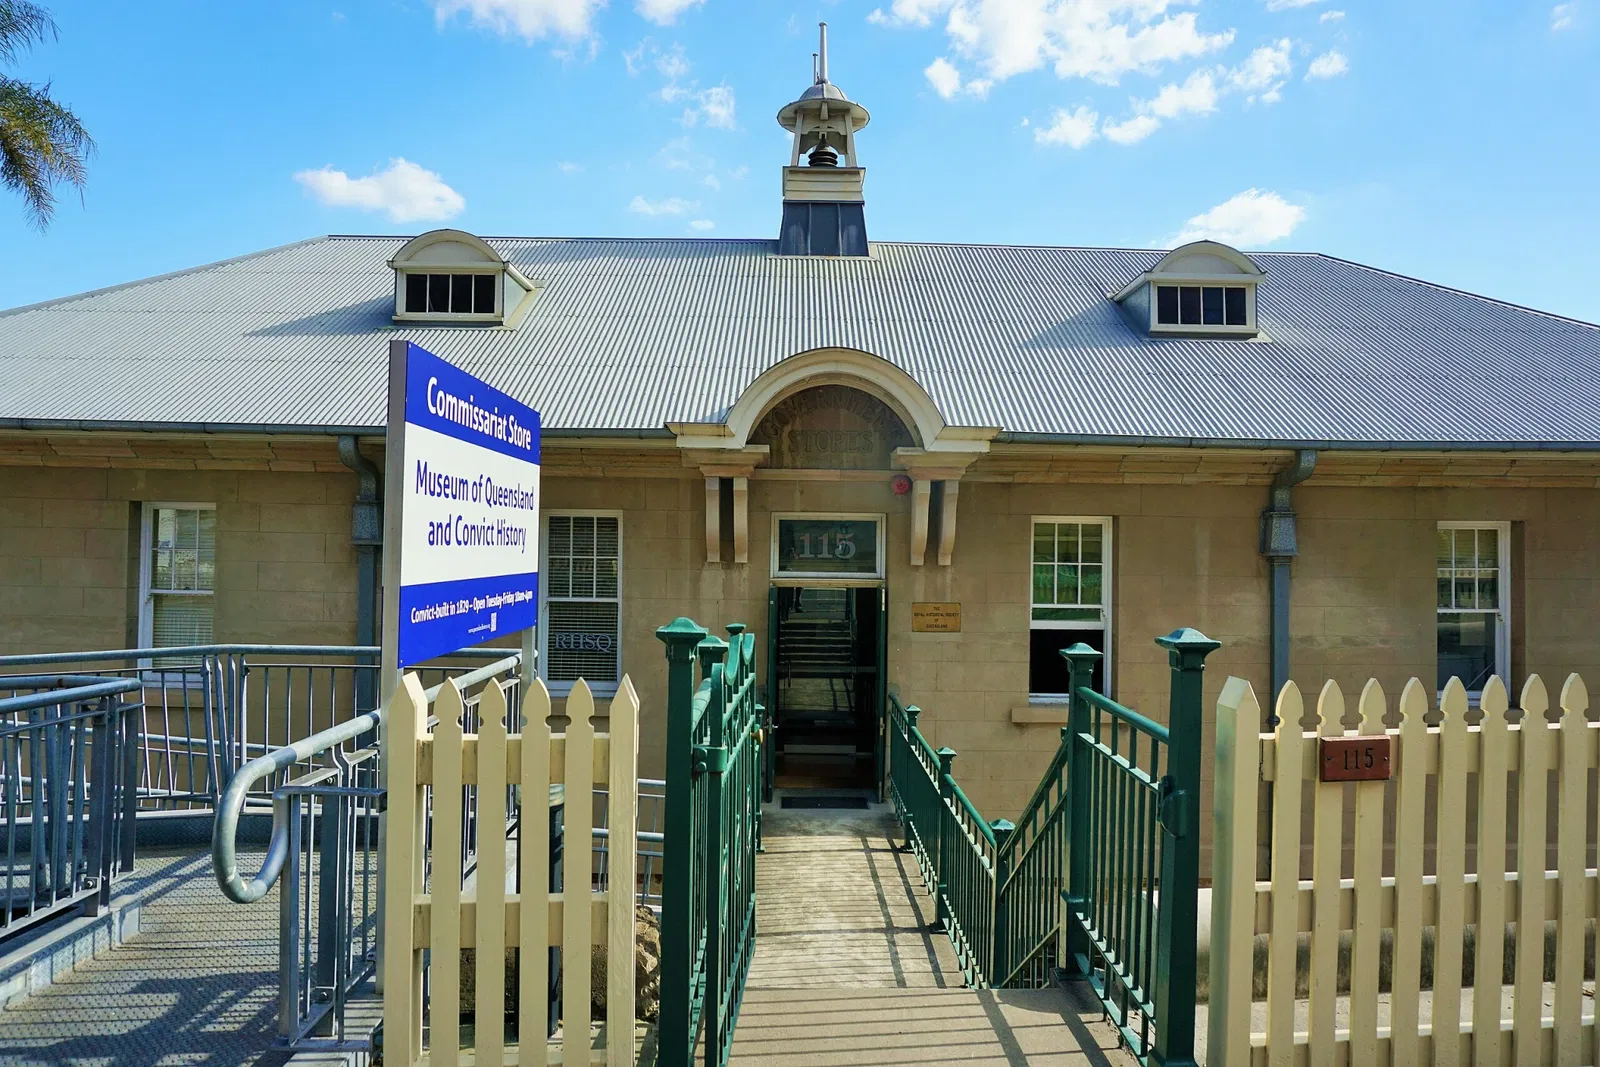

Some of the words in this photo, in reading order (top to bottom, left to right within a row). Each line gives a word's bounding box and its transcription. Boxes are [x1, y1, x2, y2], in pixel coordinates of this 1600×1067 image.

[427, 376, 507, 441] Commissariat
[508, 415, 531, 450] Store
[788, 429, 873, 453] STORES
[416, 459, 469, 501] Museum
[471, 474, 483, 503] of
[485, 476, 534, 510] Queensland
[428, 513, 451, 546] and
[455, 514, 494, 546] Convict
[496, 518, 527, 554] History
[799, 532, 856, 560] 115
[410, 601, 449, 624] Convict-built
[449, 601, 456, 615] in
[456, 599, 469, 614] 1829
[473, 596, 485, 613] Open
[555, 632, 612, 653] RHSQ
[1343, 747, 1374, 771] 115
